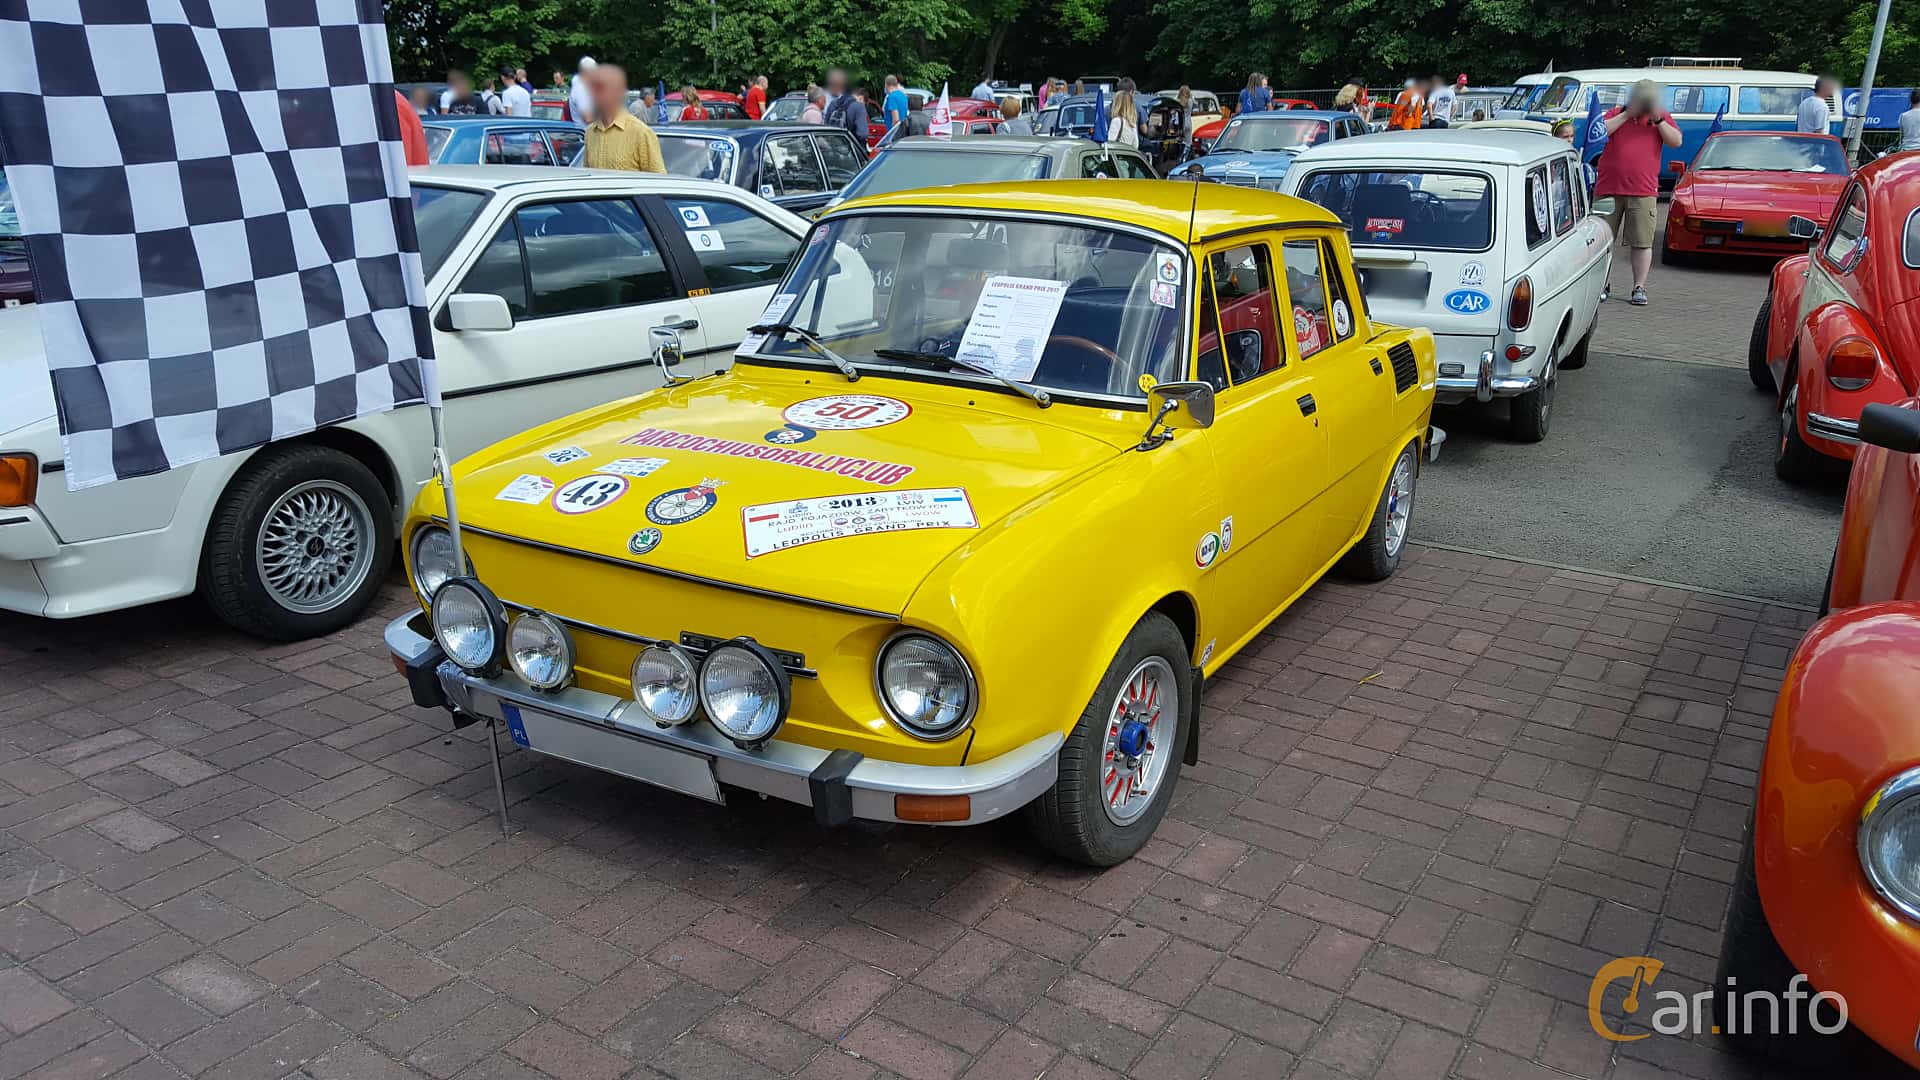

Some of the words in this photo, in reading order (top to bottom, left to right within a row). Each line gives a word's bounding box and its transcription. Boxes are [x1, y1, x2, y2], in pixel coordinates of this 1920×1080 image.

[1450, 293, 1484, 311] CAR
[814, 402, 879, 420] 50
[618, 428, 913, 485] PARCOCHIUSORALLYCLUB
[563, 480, 621, 506] 43
[829, 496, 877, 509] 2013
[768, 519, 796, 527] RAJD
[773, 531, 844, 550] LEOPOLIS
[855, 523, 906, 533] GRAND
[513, 728, 527, 741] PL
